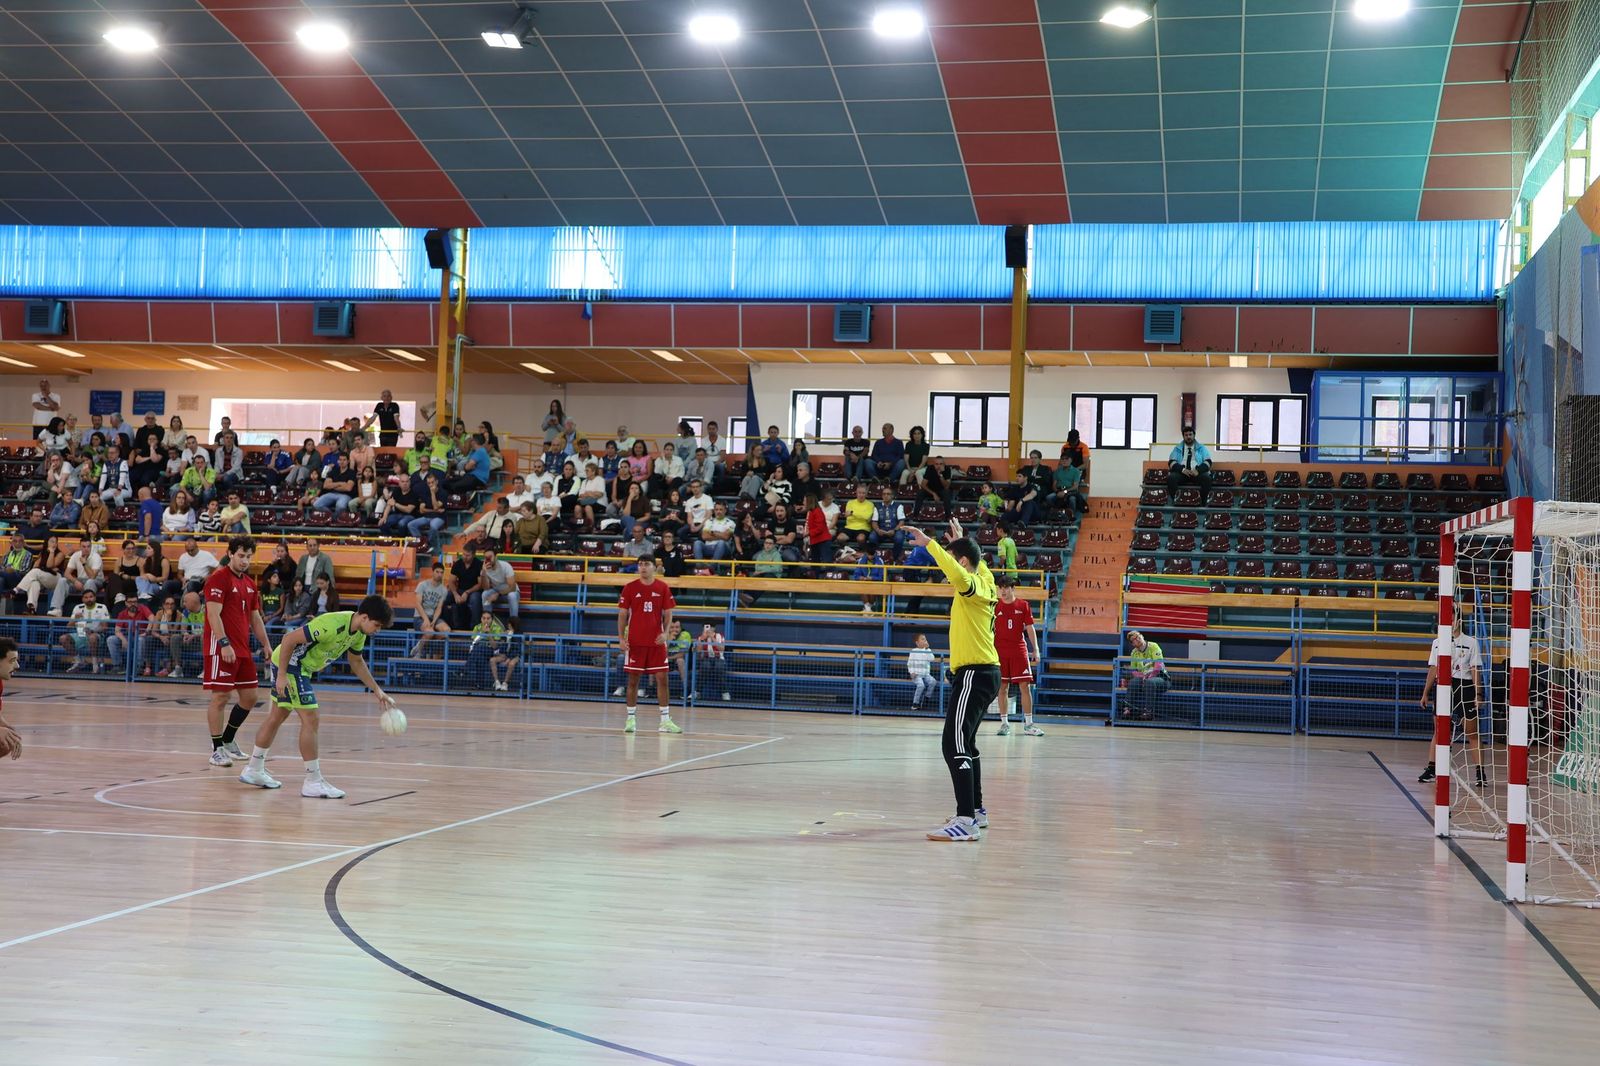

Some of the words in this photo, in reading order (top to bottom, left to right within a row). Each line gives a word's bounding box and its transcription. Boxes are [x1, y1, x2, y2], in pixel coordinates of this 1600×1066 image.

[1090, 533, 1112, 542] FILA
[1084, 556, 1107, 565] FILA
[1078, 580, 1101, 589] FILA
[644, 602, 652, 612] 99
[1072, 606, 1095, 615] FILA
[1008, 619, 1012, 629] 8
